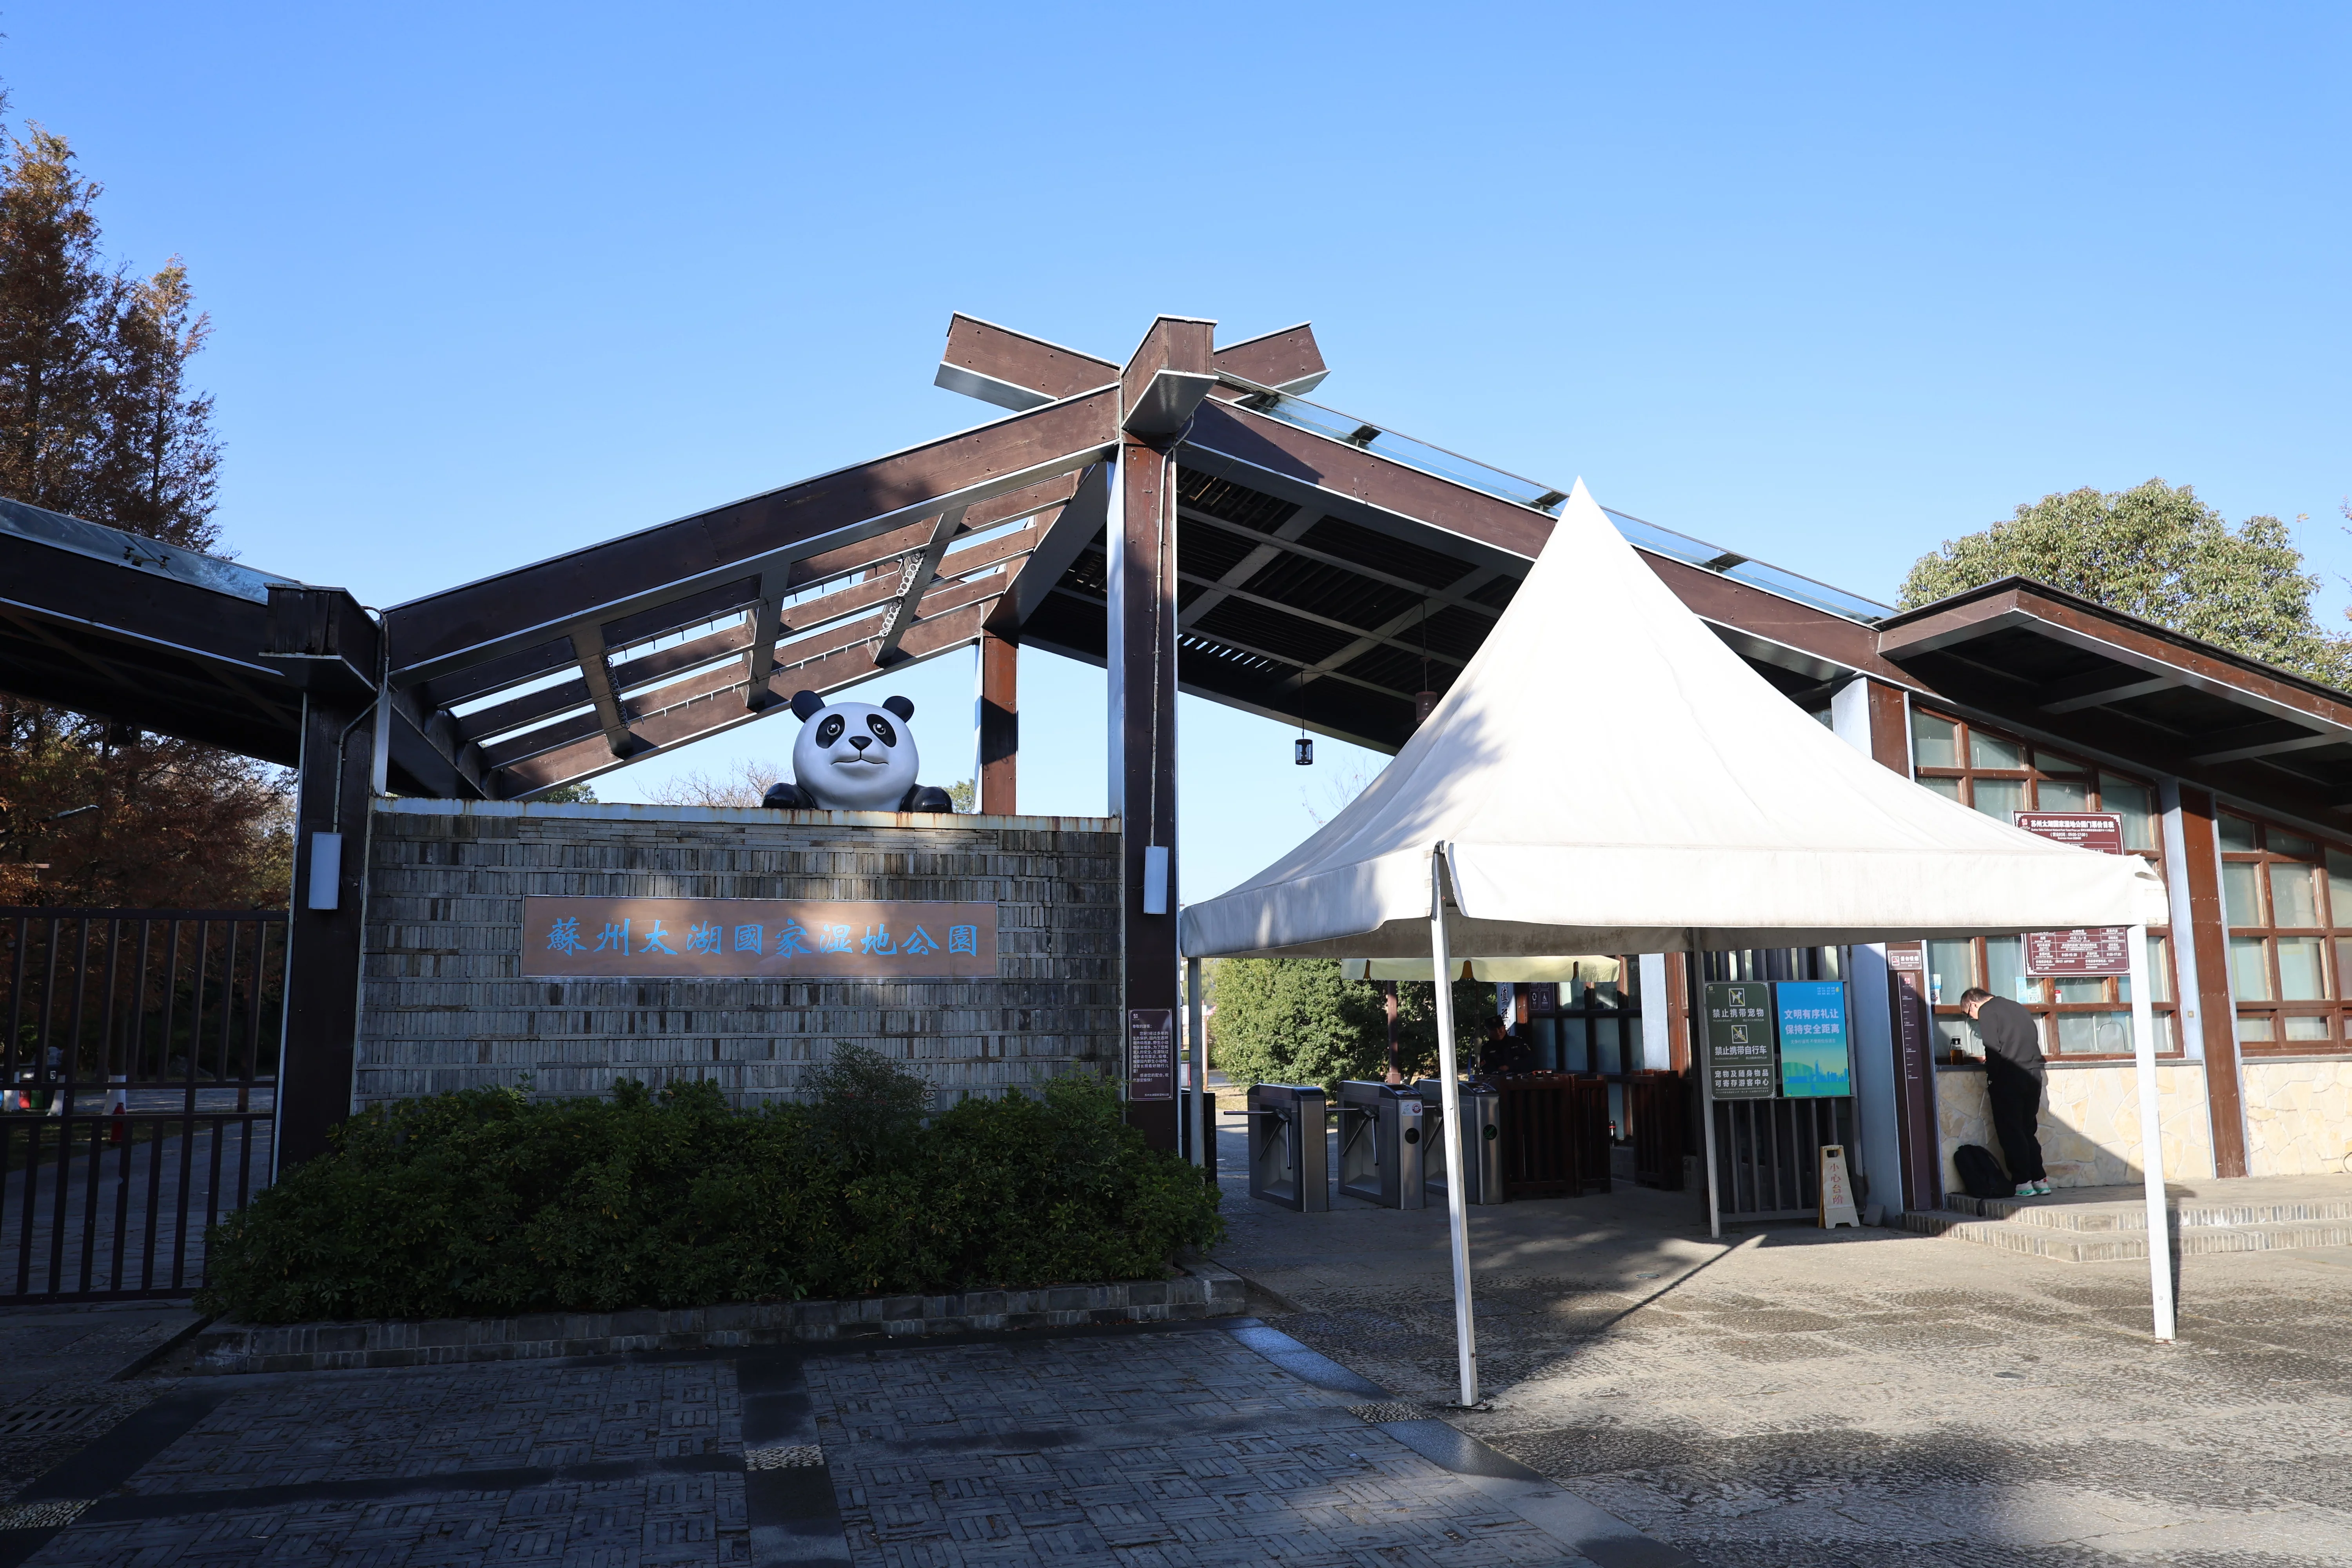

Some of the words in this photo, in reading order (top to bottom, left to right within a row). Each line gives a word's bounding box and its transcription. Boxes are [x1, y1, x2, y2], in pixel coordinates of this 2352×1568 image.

[1713, 1008, 1764, 1018] 禁止携带宠物
[1784, 1009, 1839, 1020] 文明有序礼让
[1785, 1024, 1839, 1035] 保持安全距离
[1715, 1045, 1767, 1055] 禁止携带自行车
[1715, 1069, 1769, 1078] 宠物及随身物品
[1715, 1078, 1769, 1087] 可寄存游客中心
[1830, 1163, 1843, 1204] 小心台阶
